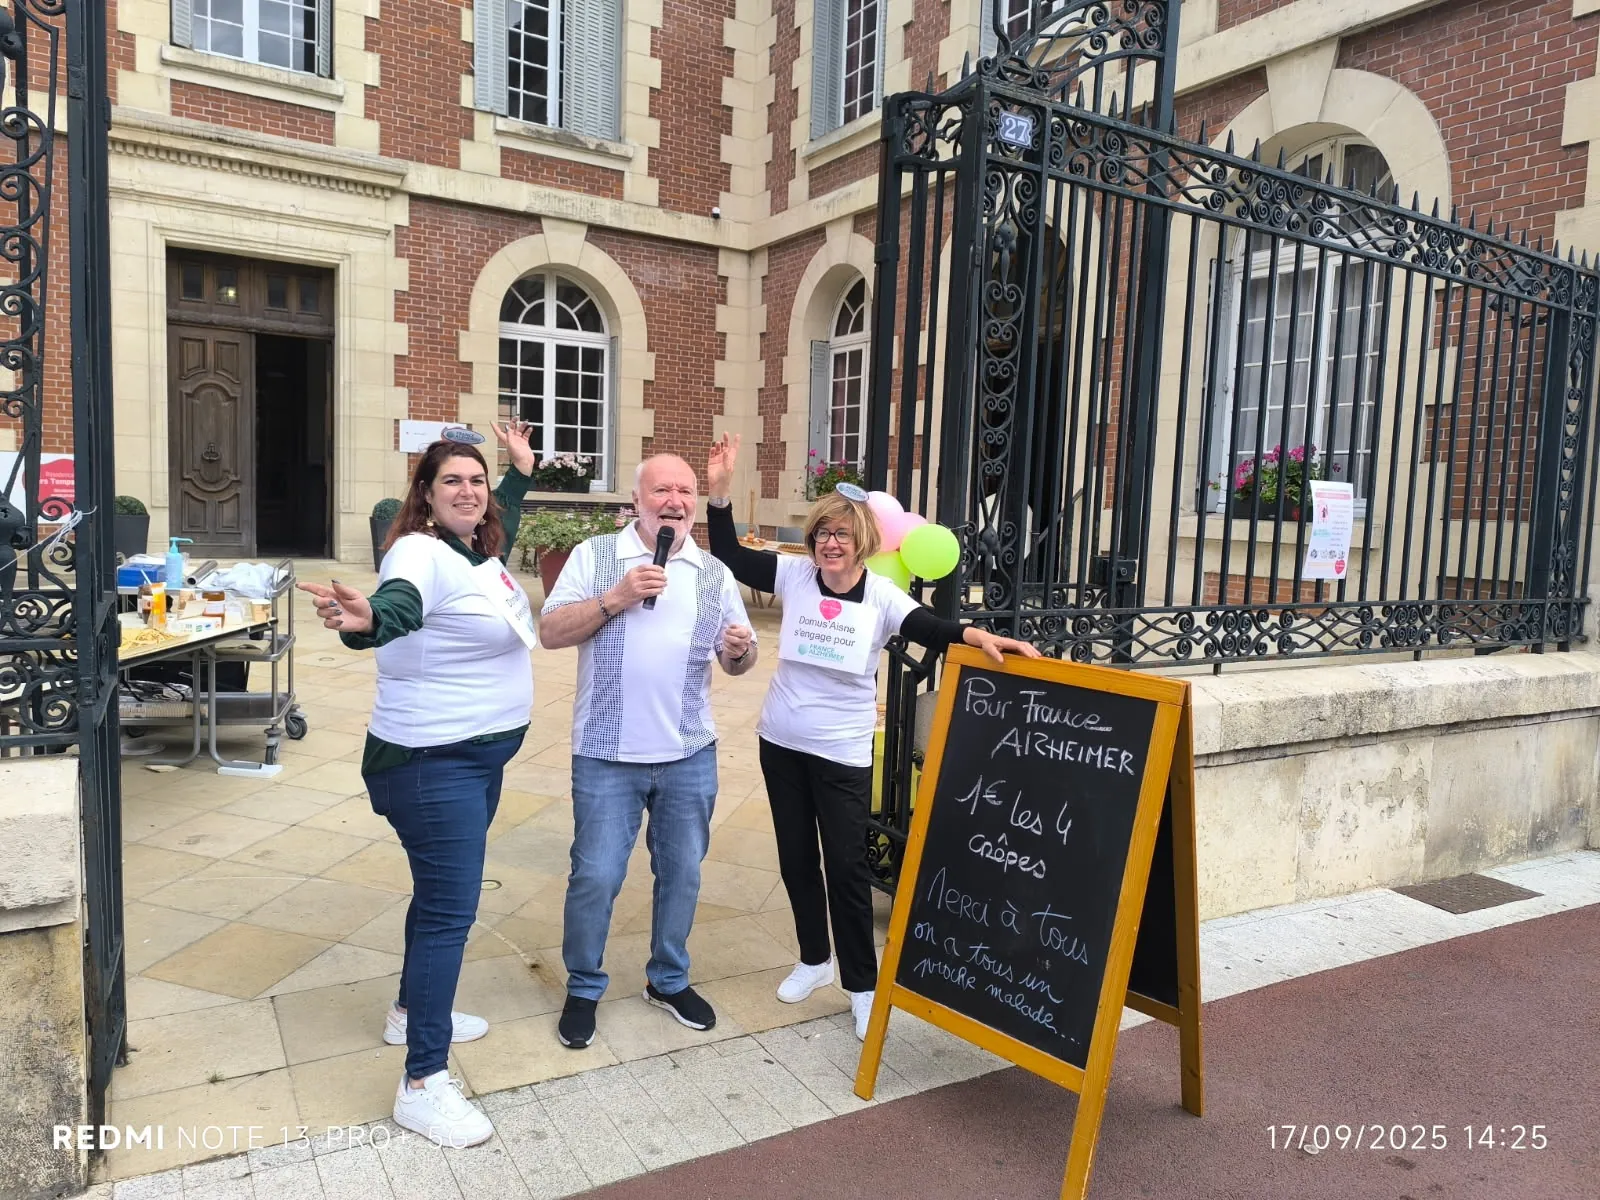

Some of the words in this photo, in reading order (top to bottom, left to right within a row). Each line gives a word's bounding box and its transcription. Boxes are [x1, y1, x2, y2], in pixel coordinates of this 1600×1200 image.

[1004, 117, 1028, 142] 27
[794, 628, 832, 643] s'engage
[833, 636, 856, 647] pour
[798, 615, 856, 634] Domus'Aisne
[808, 643, 836, 653] FRANCE
[964, 677, 1012, 719] Pour
[1019, 691, 1112, 731] France
[955, 774, 1006, 815] 1€
[1056, 800, 1073, 845] 4
[1001, 899, 1022, 935] à
[1032, 904, 1089, 965] tous
[913, 957, 977, 991] proche
[914, 922, 937, 945] on
[944, 937, 961, 957] a
[966, 942, 1014, 983] tous
[1019, 972, 1064, 1004] un
